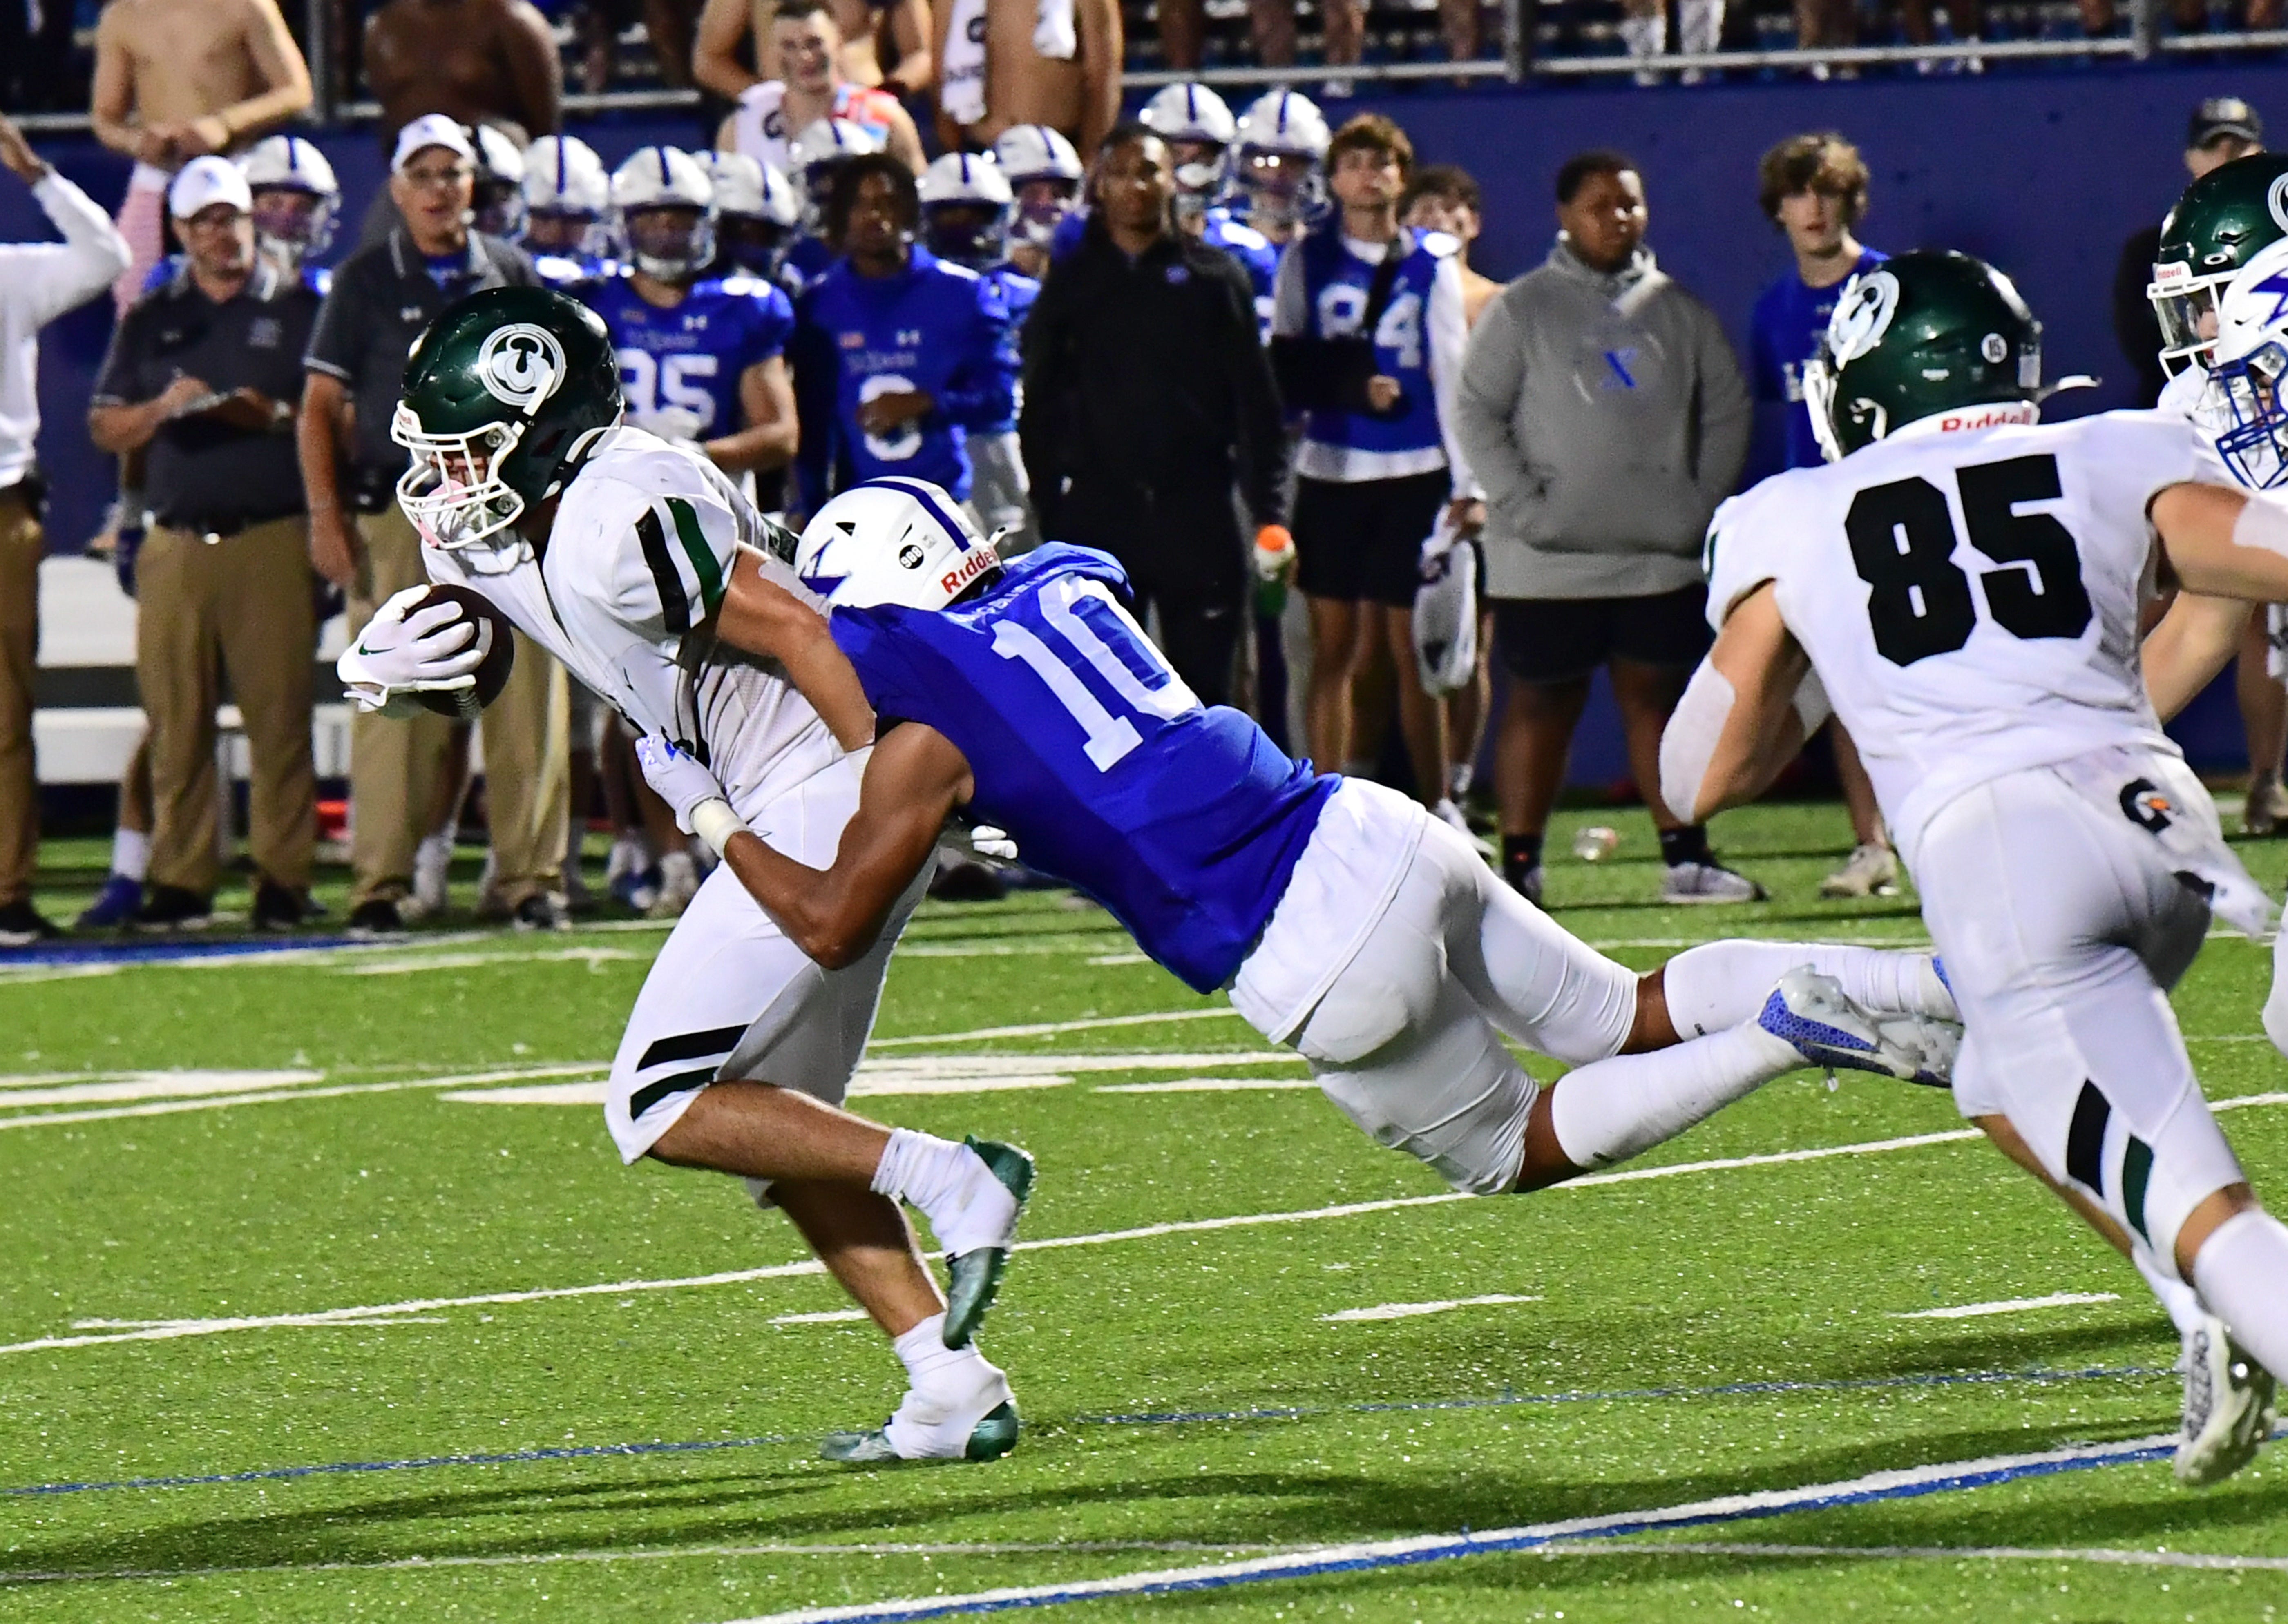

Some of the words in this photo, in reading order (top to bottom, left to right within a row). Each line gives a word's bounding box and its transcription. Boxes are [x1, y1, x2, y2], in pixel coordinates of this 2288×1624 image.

[900, 546, 923, 568] 988
[1844, 453, 2094, 668] 85
[990, 573, 1198, 773] 10
